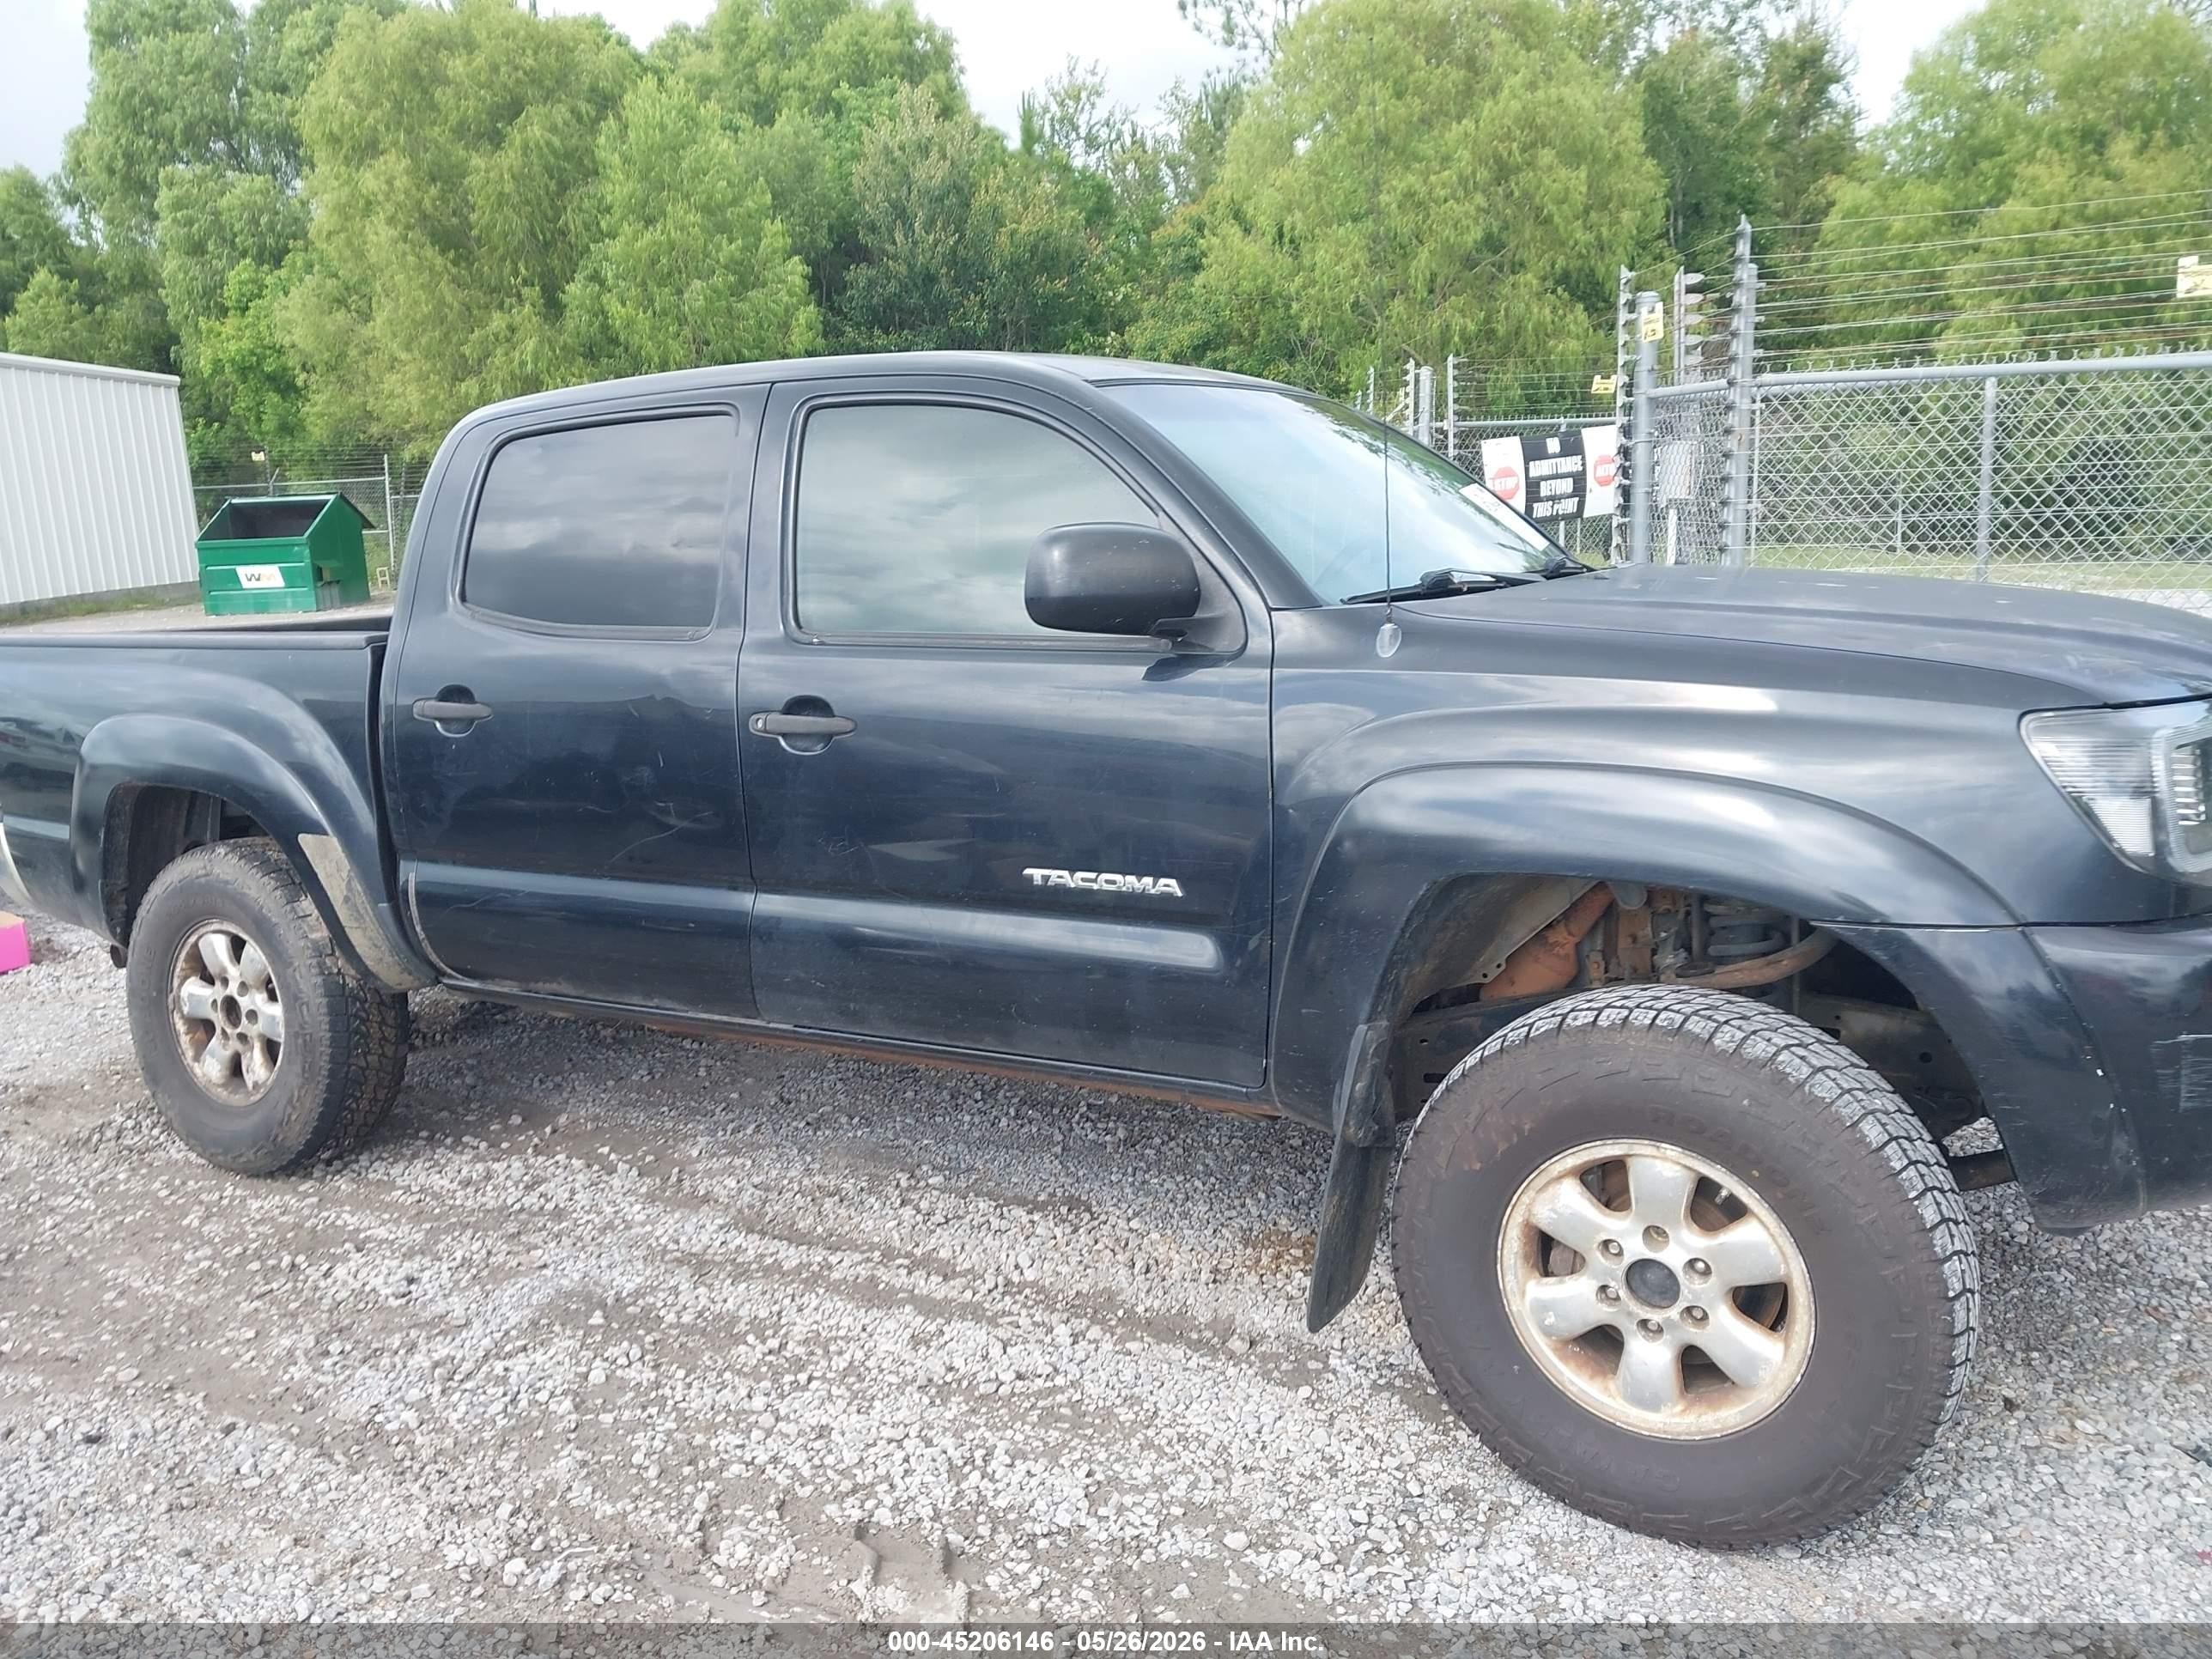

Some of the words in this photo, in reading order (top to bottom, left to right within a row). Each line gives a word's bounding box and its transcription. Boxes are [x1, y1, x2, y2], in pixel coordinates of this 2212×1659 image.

[1546, 437, 1561, 454] NO
[1529, 455, 1583, 477] ADMITTANCE
[1494, 476, 1518, 491] STOP
[1540, 477, 1573, 497] BEYOND
[1533, 501, 1552, 519] THIS
[1553, 497, 1579, 516] POINT
[1022, 867, 1183, 896] TACOMA
